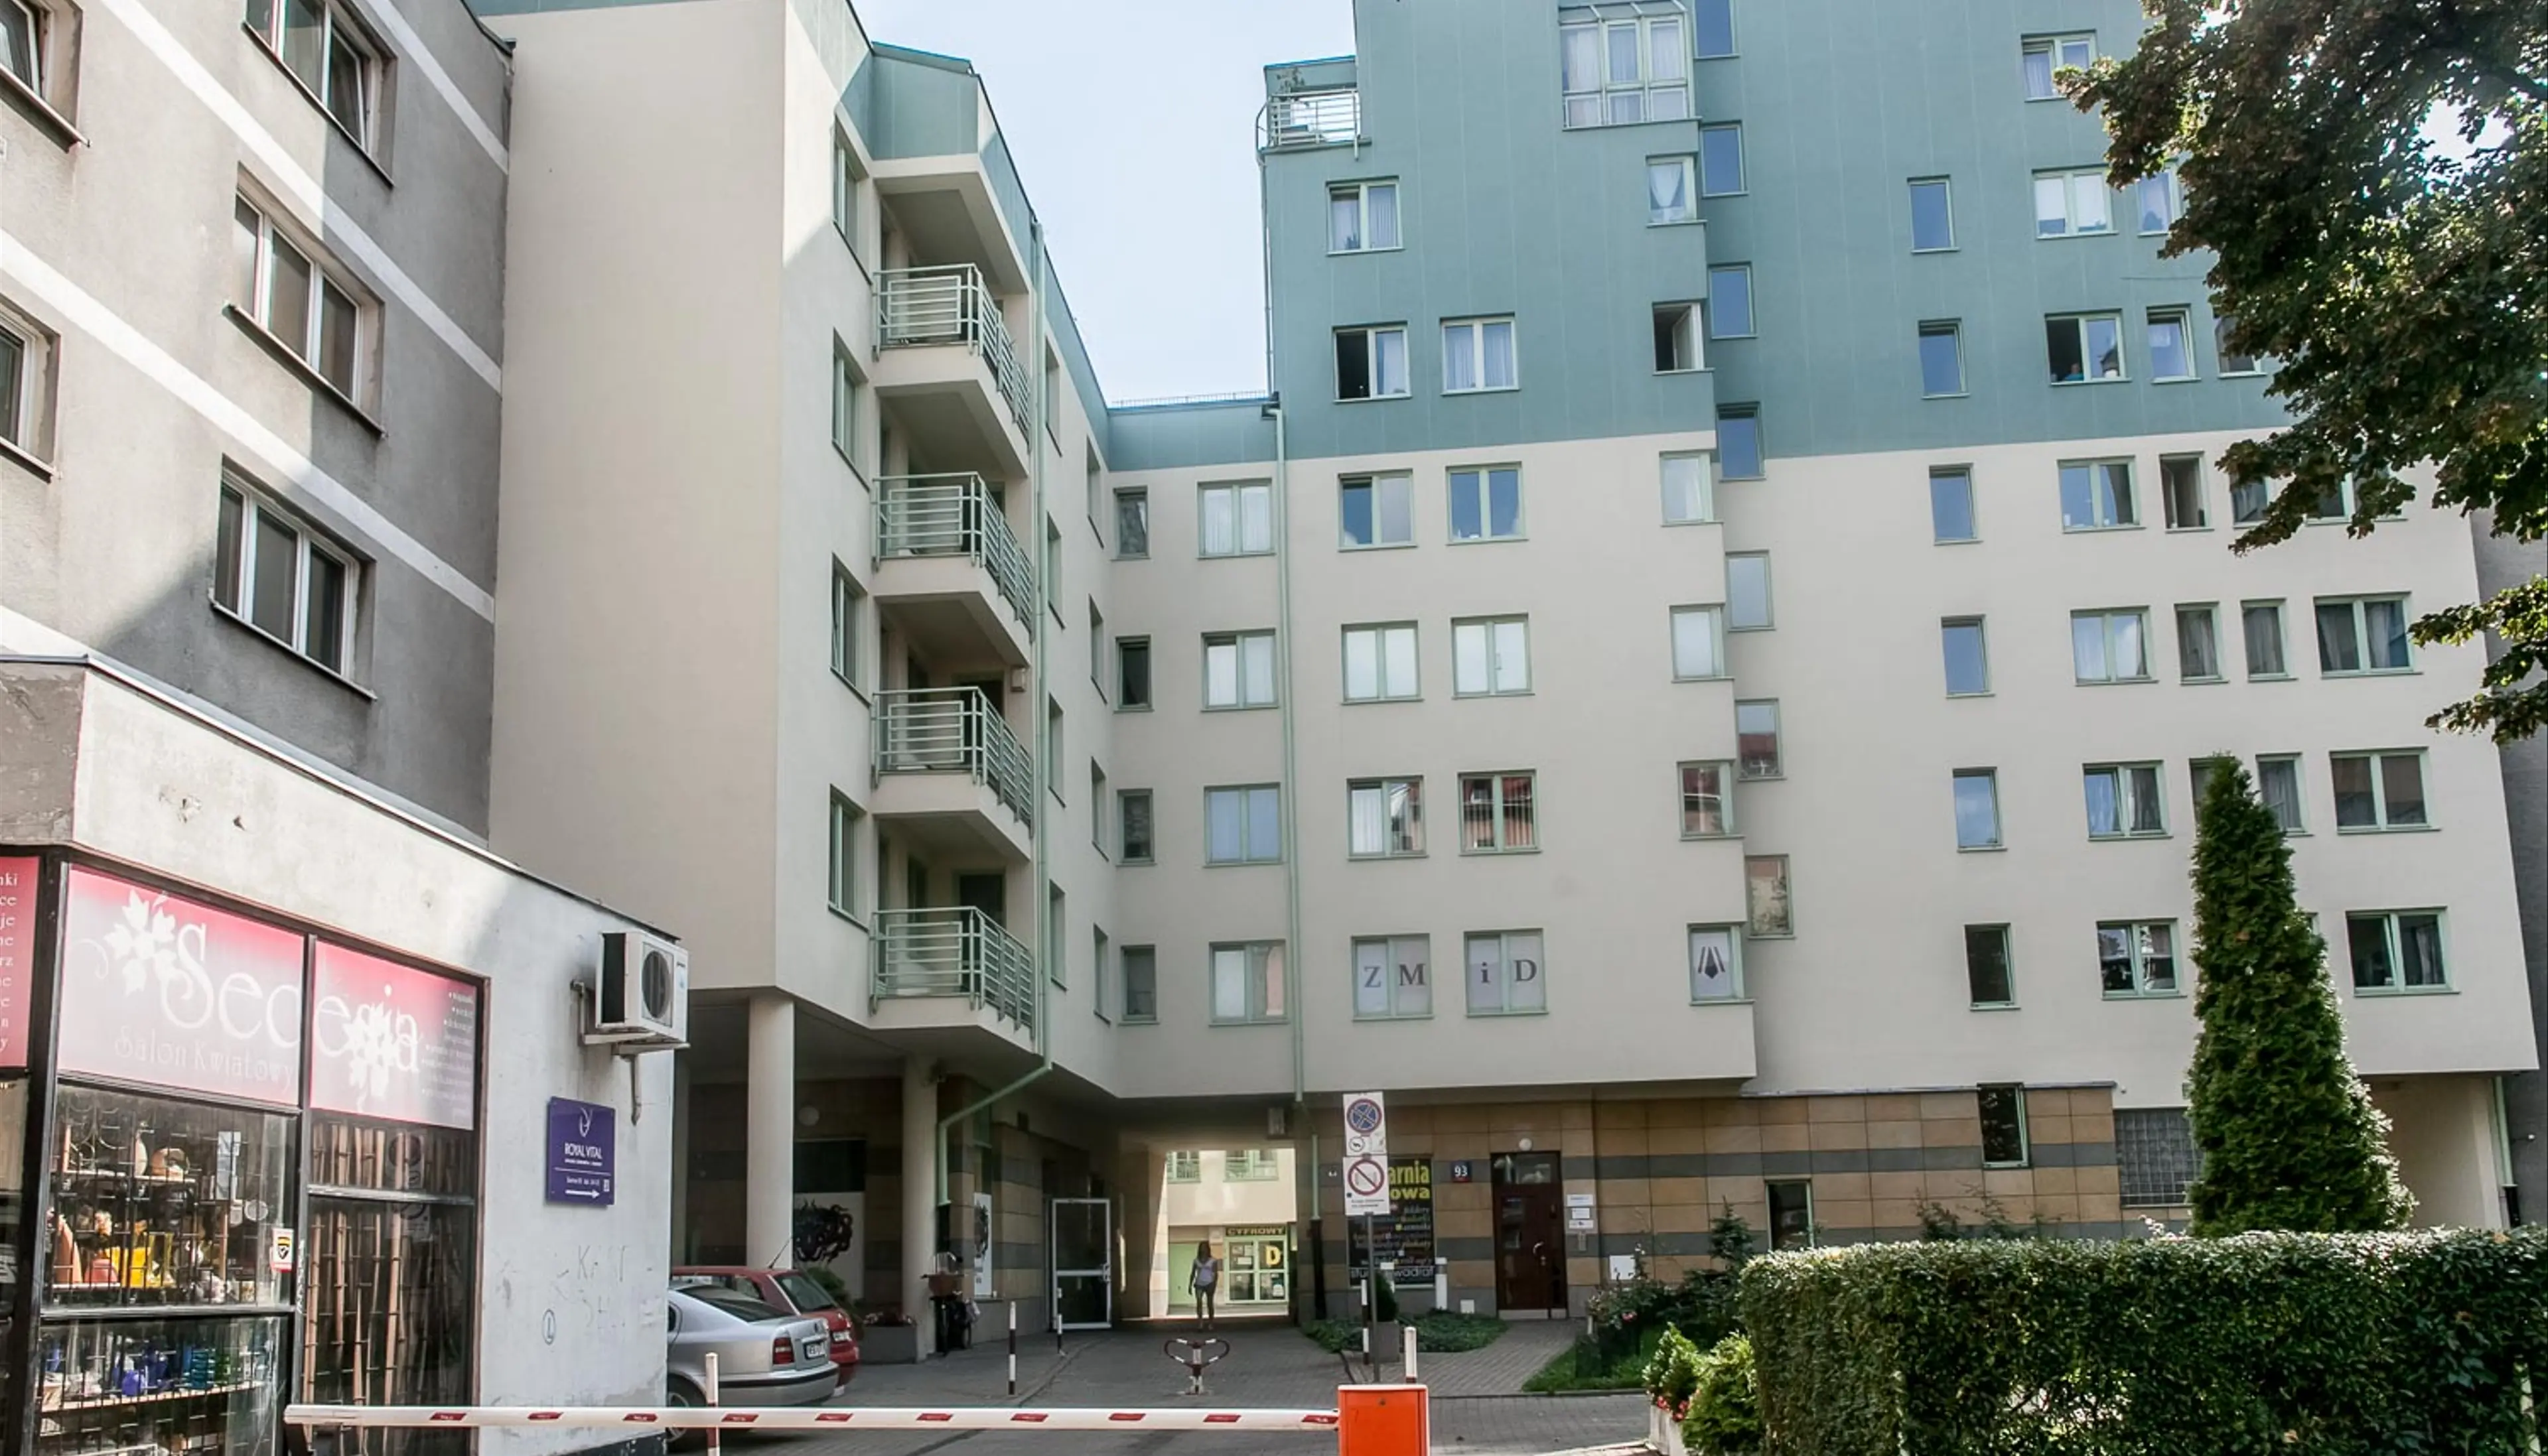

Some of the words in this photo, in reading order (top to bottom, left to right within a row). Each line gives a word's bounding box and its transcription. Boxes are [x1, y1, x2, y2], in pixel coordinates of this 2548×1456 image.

[115, 1026, 188, 1068] Salon
[565, 1142, 585, 1158] ROYAL
[585, 1146, 603, 1159] VITAL
[1454, 1165, 1467, 1177] 93
